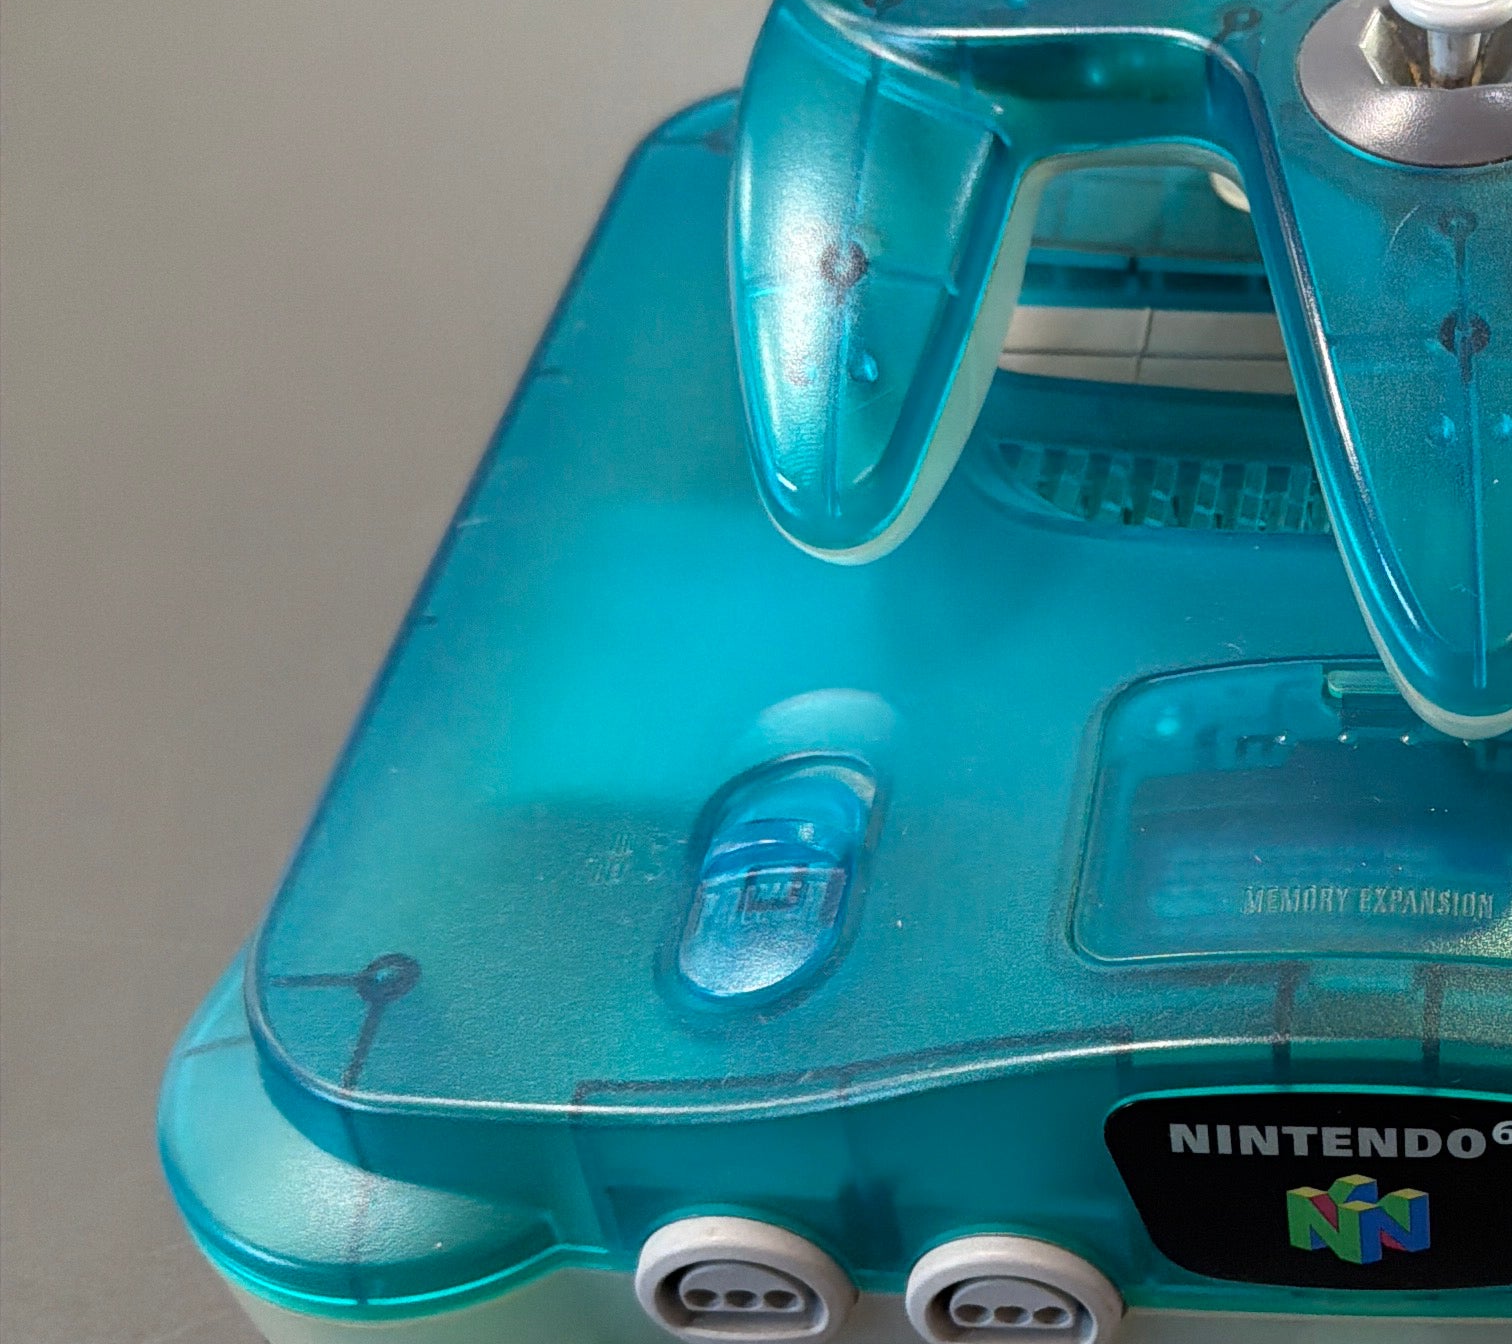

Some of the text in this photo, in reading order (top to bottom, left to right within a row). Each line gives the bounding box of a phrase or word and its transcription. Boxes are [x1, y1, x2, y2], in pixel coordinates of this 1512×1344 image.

[1242, 884, 1495, 919] MEMORY EXPANSION
[1168, 1122, 1487, 1159] NINTENDO
